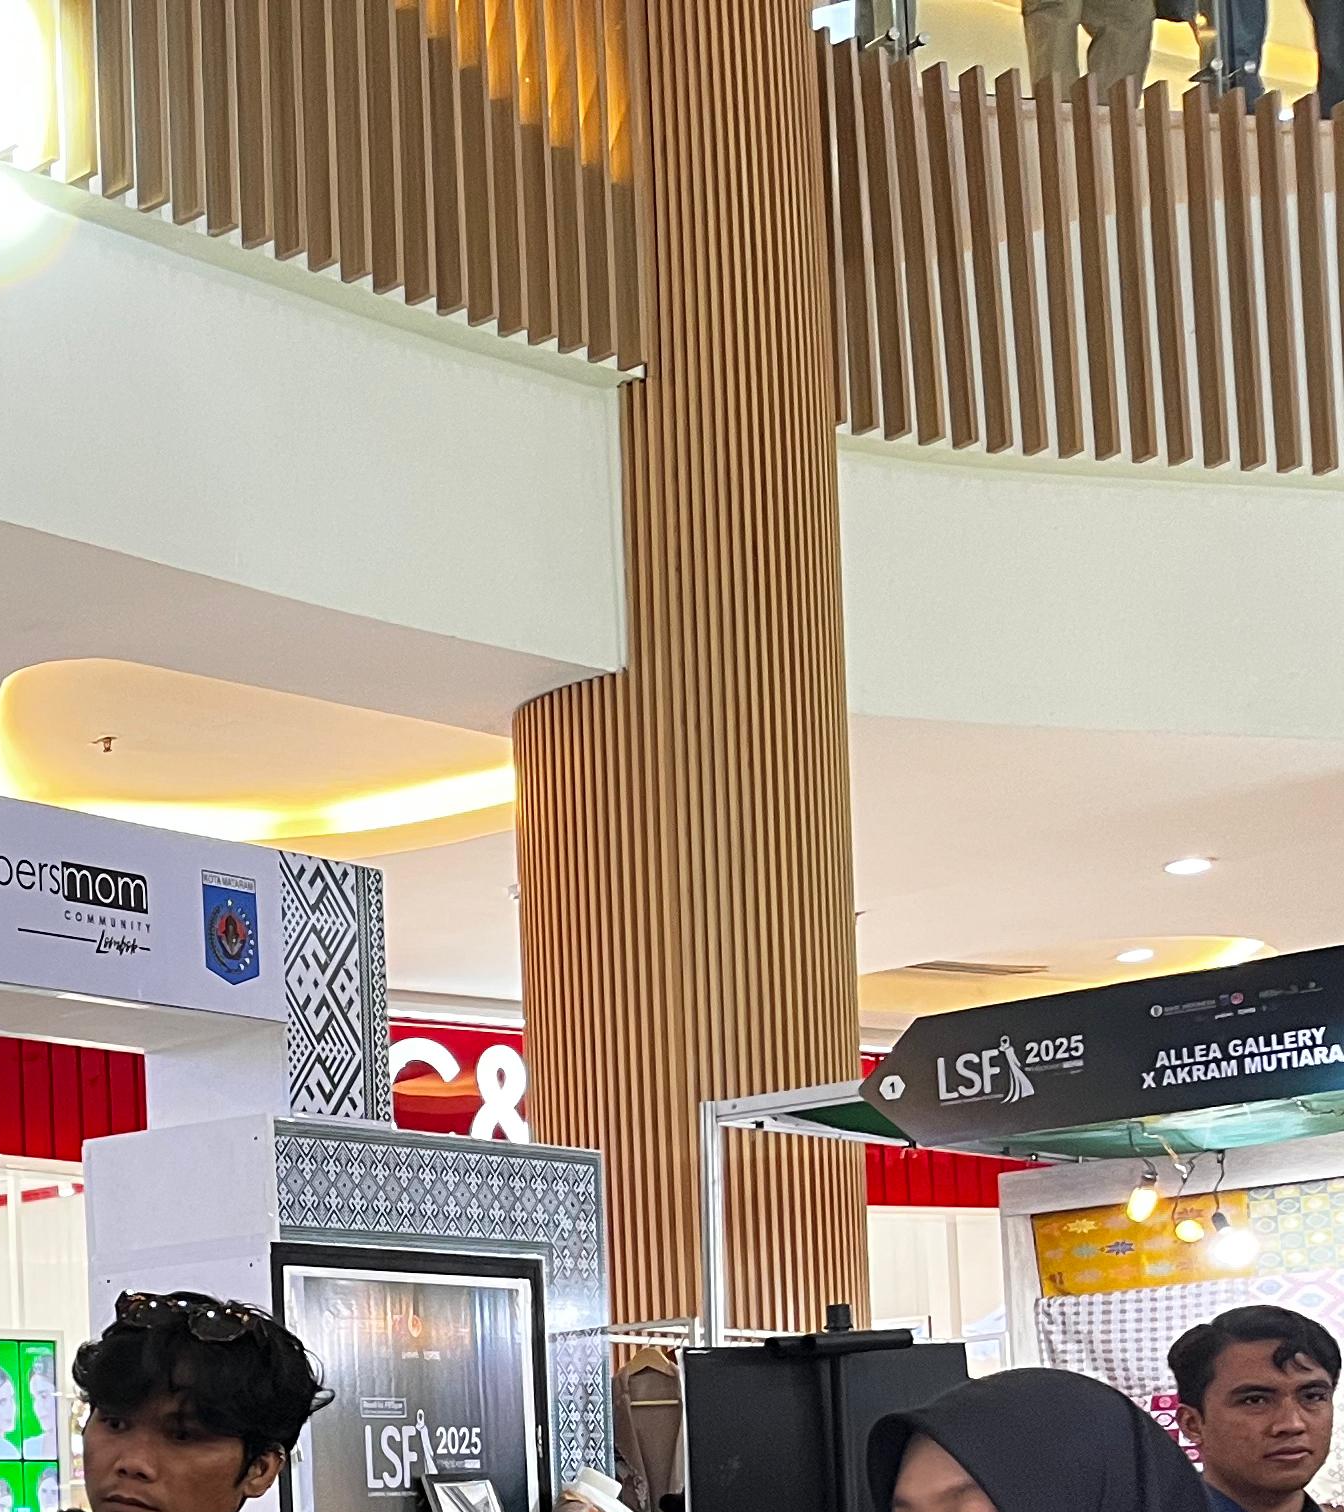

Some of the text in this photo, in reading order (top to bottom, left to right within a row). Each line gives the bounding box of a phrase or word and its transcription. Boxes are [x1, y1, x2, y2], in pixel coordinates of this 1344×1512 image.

[64, 910, 151, 933] COMMUNITY
[937, 1034, 1084, 1100] LSF 2025
[1141, 1044, 1344, 1089] X AKRAM MUTIARA
[1155, 1026, 1326, 1068] ALLEA GALLERY
[364, 1424, 482, 1489] LSF 2025
